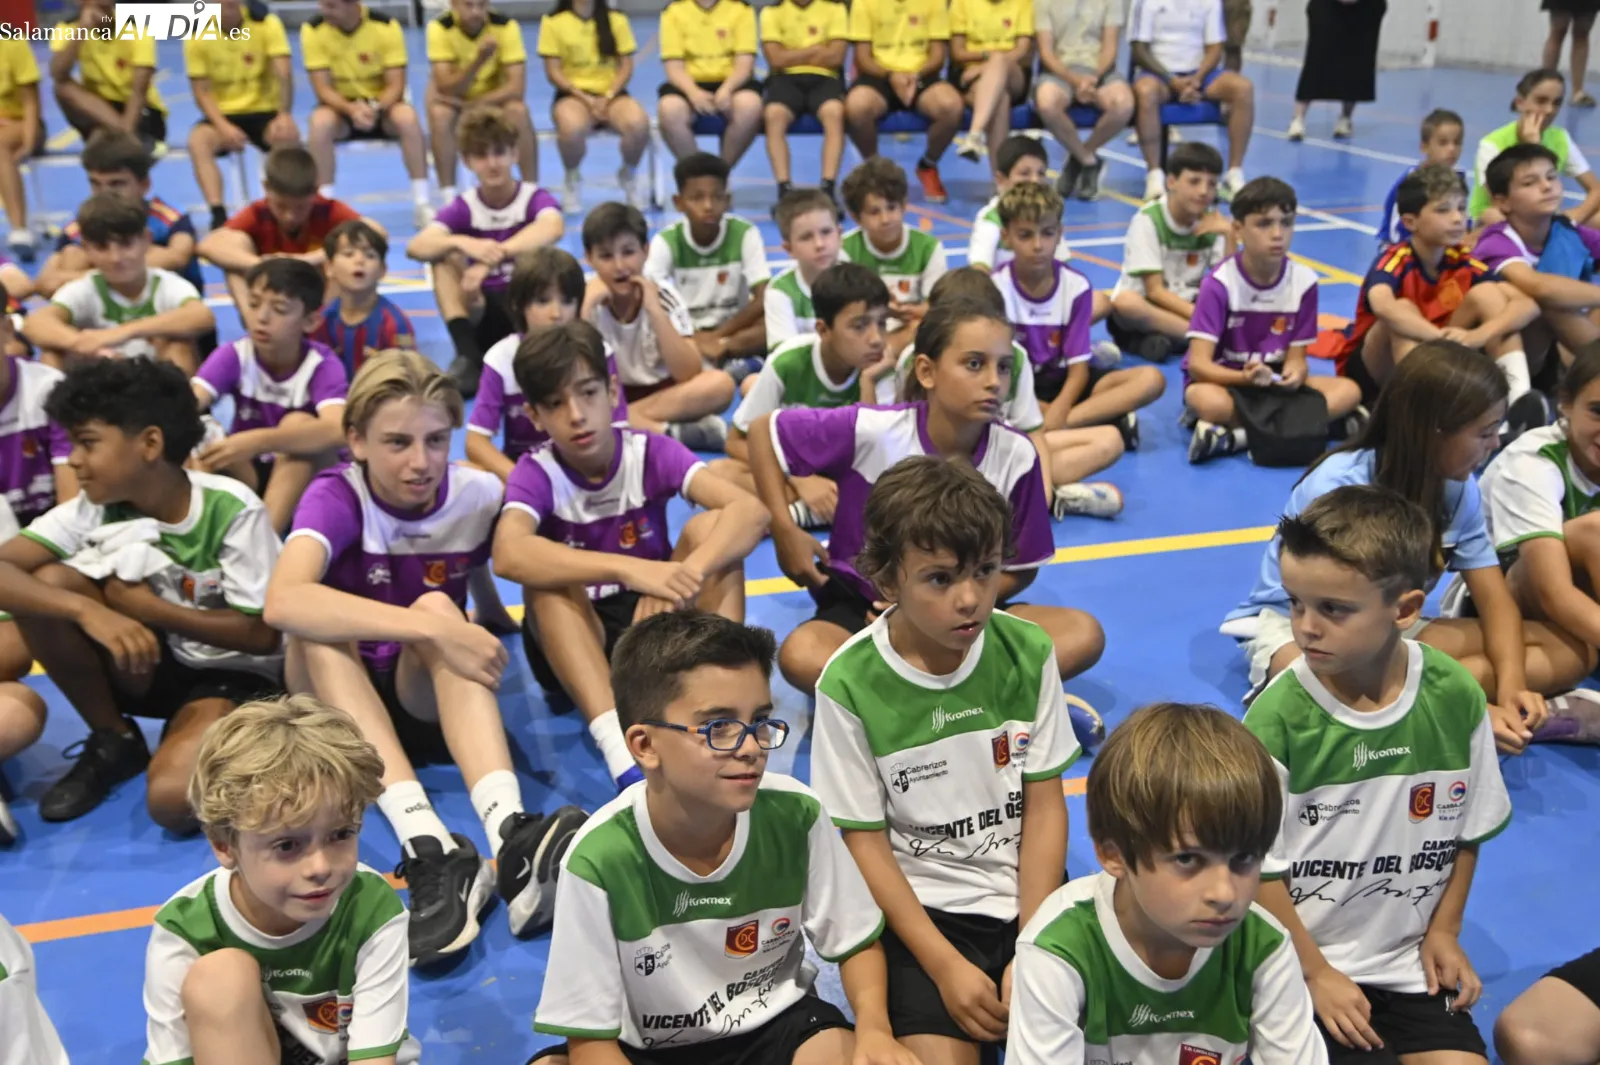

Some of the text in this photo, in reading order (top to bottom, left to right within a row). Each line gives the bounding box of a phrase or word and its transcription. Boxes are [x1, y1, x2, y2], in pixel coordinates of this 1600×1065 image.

[945, 706, 984, 721] Kromex
[1368, 745, 1411, 760] Kromex
[906, 759, 948, 775] Cabrerizos
[908, 770, 949, 784] Ayuntamiento
[978, 808, 1003, 831] DEL
[1422, 839, 1457, 851] CAMP
[1292, 859, 1367, 881] VICENTE
[1372, 855, 1402, 875] DEL
[689, 896, 732, 907] Kromex
[642, 1003, 712, 1030] VICENTE
[1149, 1009, 1195, 1024] Kromex
